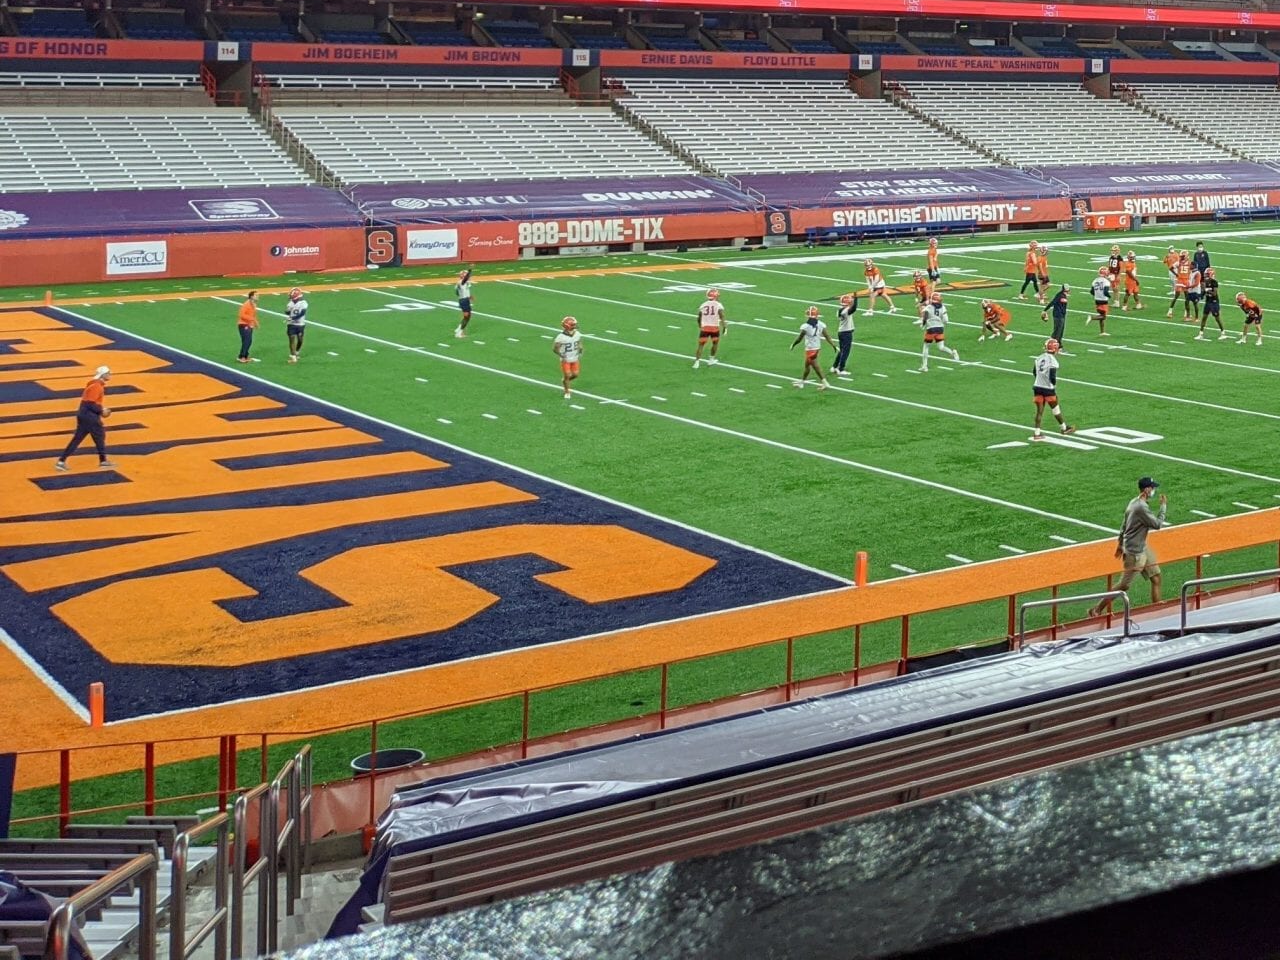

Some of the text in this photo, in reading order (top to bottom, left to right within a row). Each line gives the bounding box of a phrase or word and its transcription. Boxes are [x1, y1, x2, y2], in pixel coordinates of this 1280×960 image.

[15, 42, 39, 54] OF
[45, 42, 108, 56] HONOR
[221, 47, 236, 55] 114
[302, 48, 398, 59] JIM BOEHEIM
[443, 50, 521, 61] JIM BROWN
[641, 54, 713, 65] ERNIE DAVIS
[743, 55, 816, 66] FLOYD LITTLE
[917, 58, 957, 68] DWAYNE
[1001, 60, 1060, 70] WASHINGTON
[1141, 174, 1185, 182] YOUR
[840, 181, 891, 189] STAY
[835, 190, 886, 198] STAY
[427, 195, 529, 207] SEFCU
[1124, 193, 1268, 214] SYRACUSE UNIVERSITY
[832, 203, 1016, 227] SYRACUSE UNIVERSITY
[769, 213, 786, 233] S
[518, 217, 664, 246] 888-DOME-TIX
[367, 230, 394, 264] S
[408, 240, 455, 251] KinneyDrugs
[109, 250, 165, 265] AmeriCU
[703, 306, 716, 316] 31
[1039, 359, 1046, 372] 2
